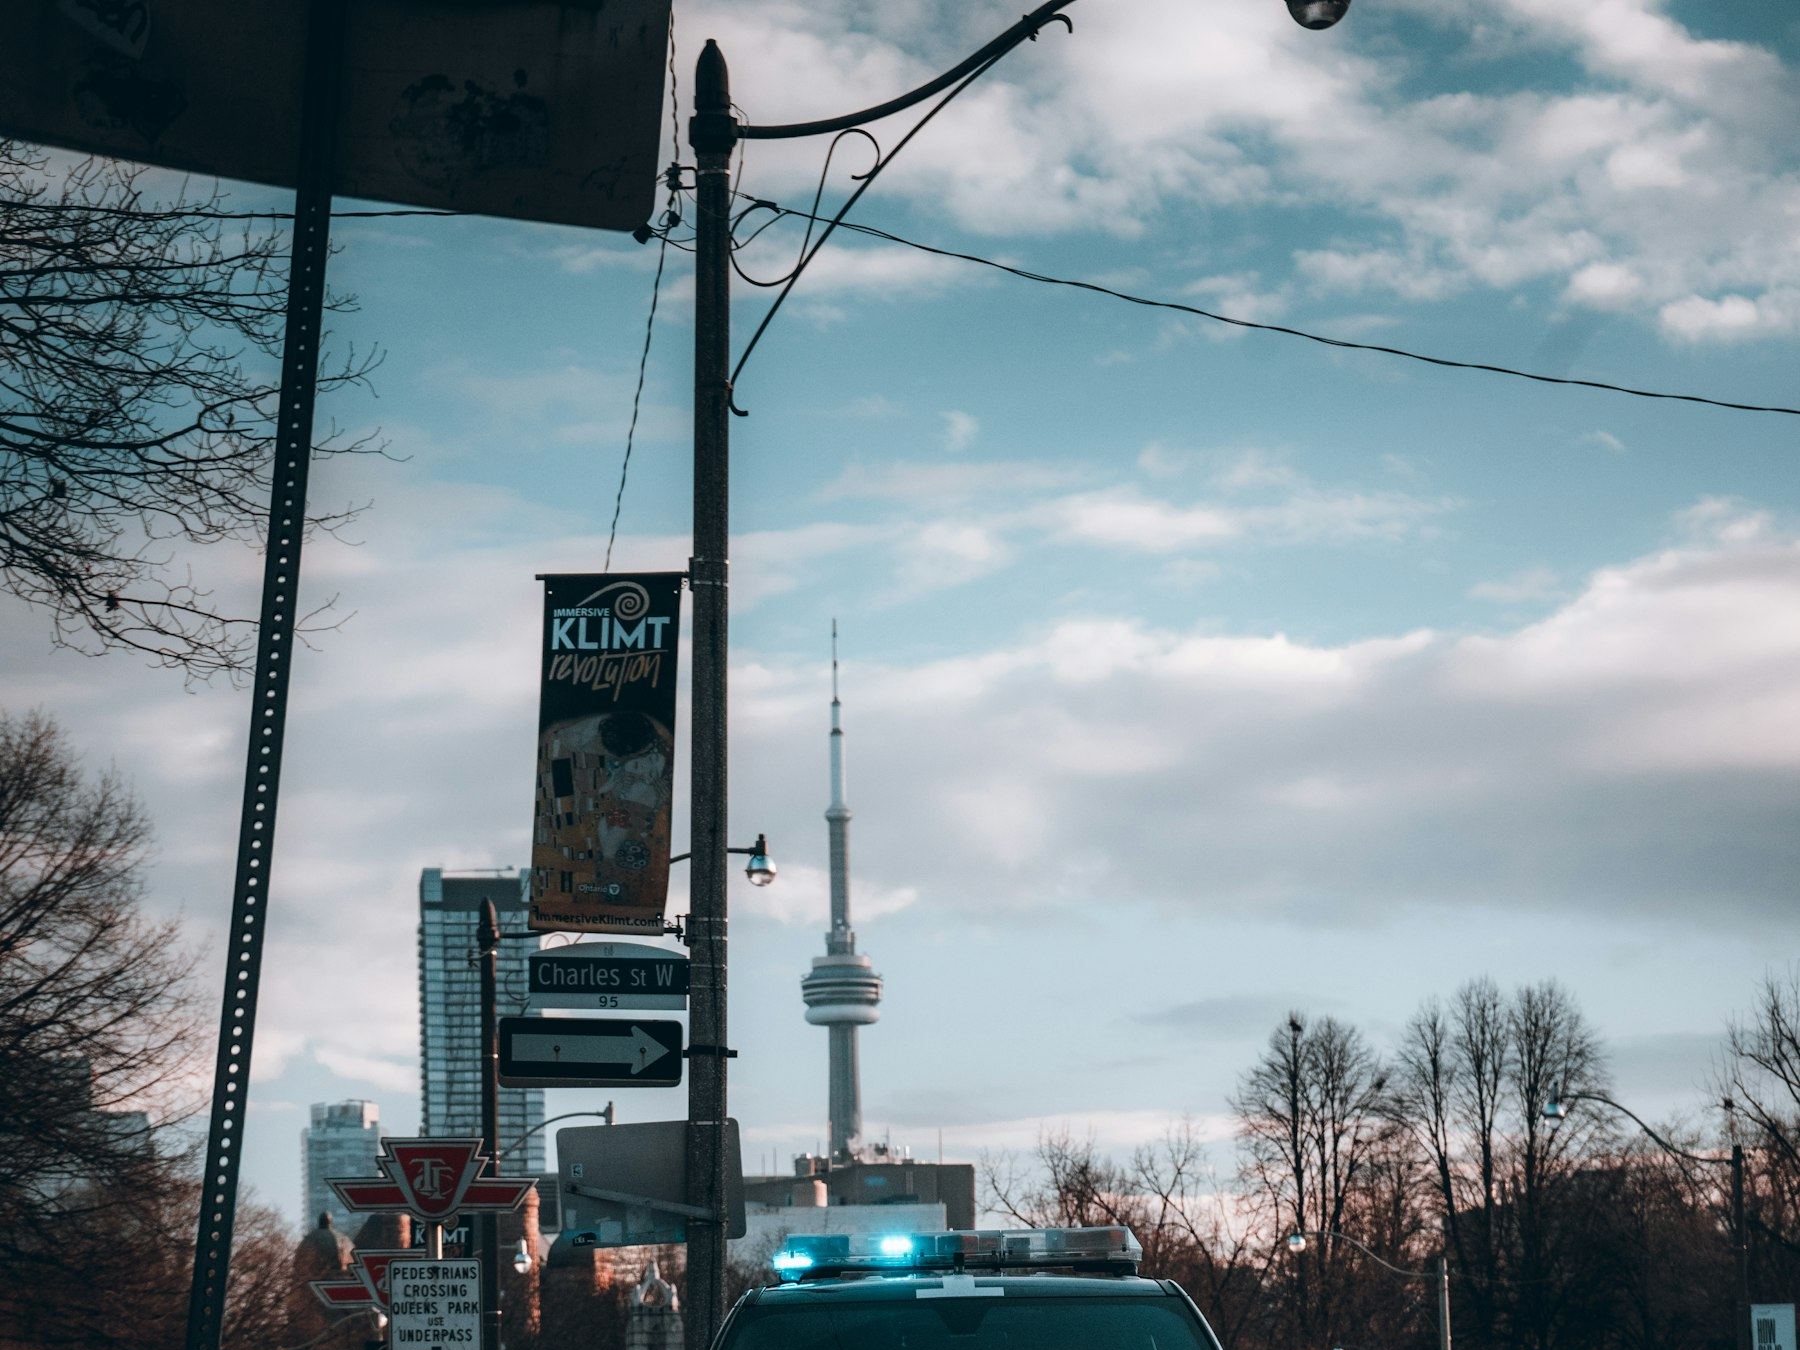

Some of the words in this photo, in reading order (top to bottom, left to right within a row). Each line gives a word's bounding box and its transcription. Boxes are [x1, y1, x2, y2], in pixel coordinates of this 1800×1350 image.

[553, 608, 610, 617] IMMERSIVE
[552, 616, 671, 650] KLIMT
[538, 963, 620, 986] Charles
[630, 968, 646, 986] St
[656, 964, 673, 987] W
[599, 996, 618, 1008] 95
[392, 1266, 477, 1280] PEDESTRIANS
[403, 1284, 468, 1298] CROSSING
[392, 1302, 438, 1315] QUEENS
[447, 1301, 480, 1315] PARK
[428, 1317, 445, 1326] USE
[399, 1328, 473, 1342] UNDERPASS
